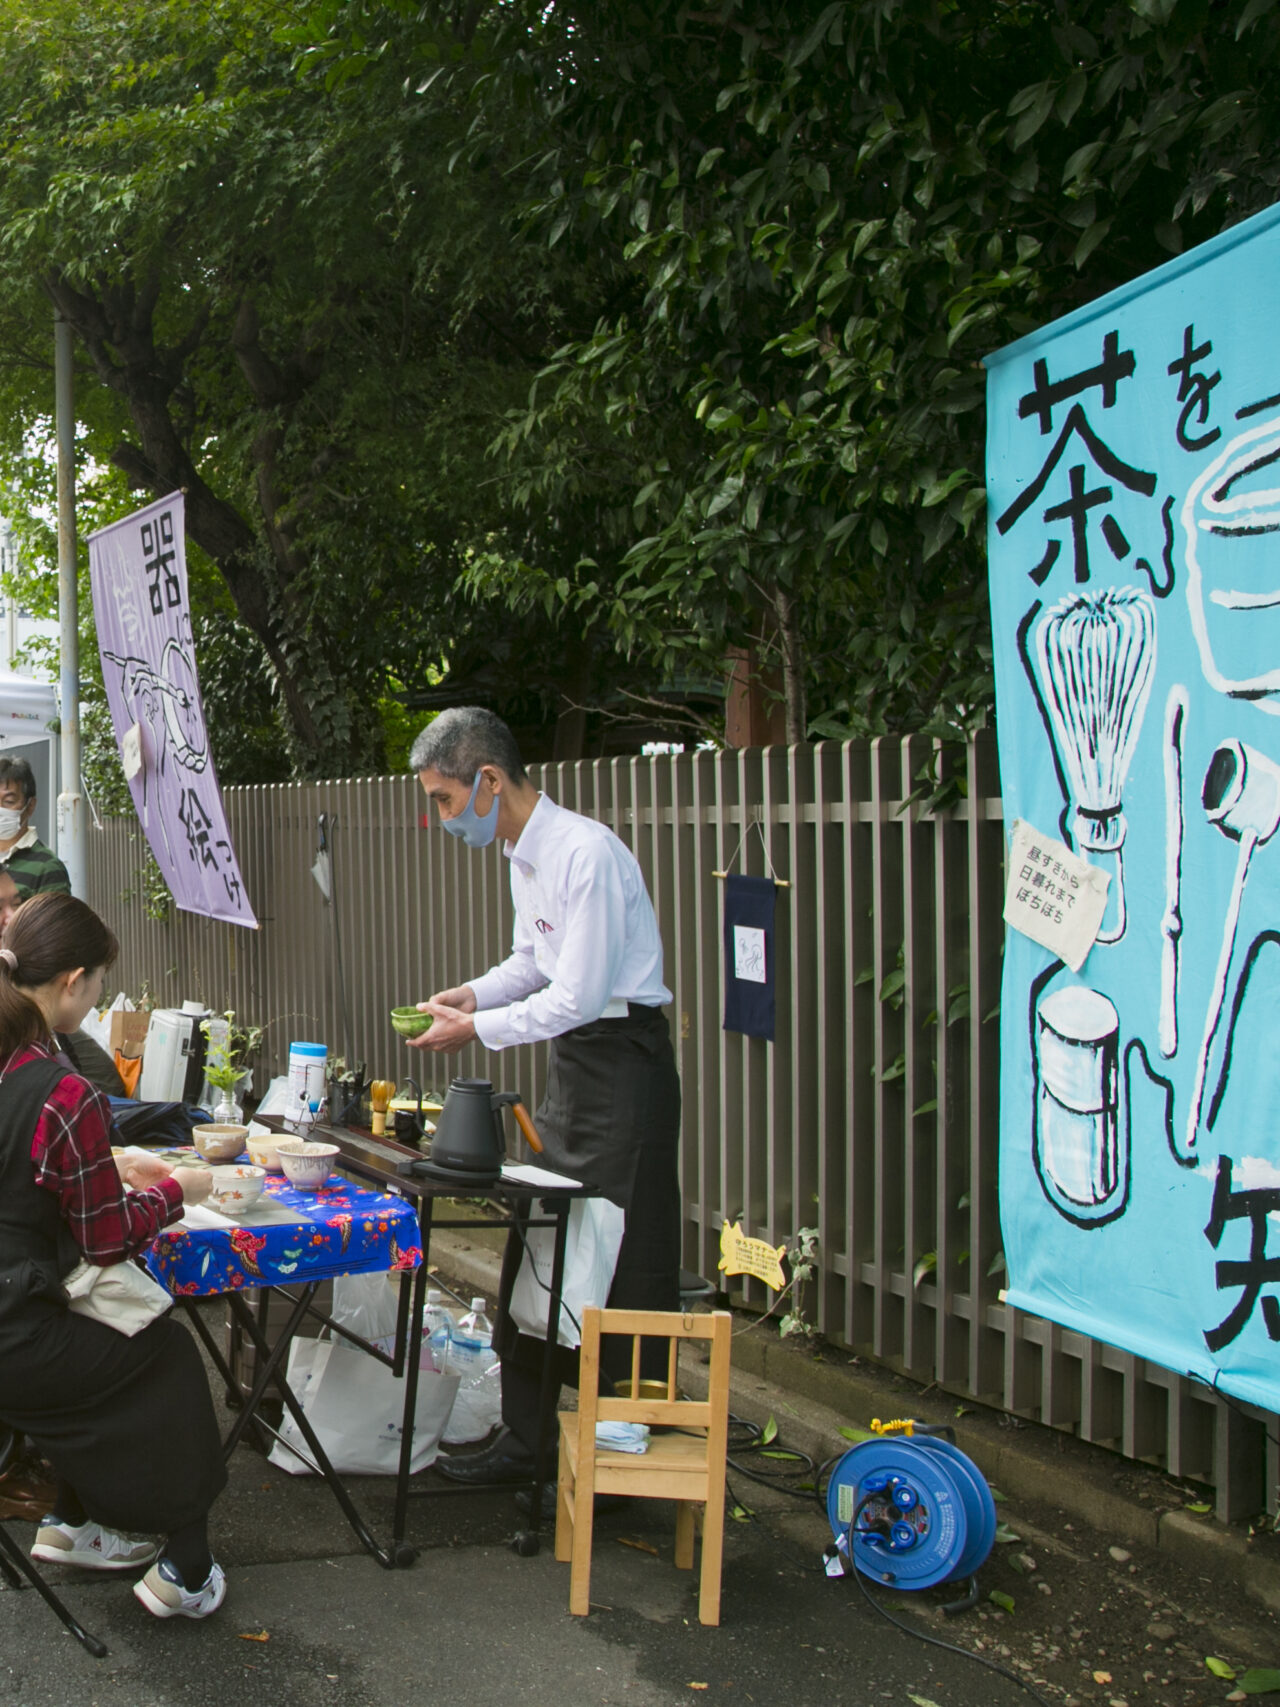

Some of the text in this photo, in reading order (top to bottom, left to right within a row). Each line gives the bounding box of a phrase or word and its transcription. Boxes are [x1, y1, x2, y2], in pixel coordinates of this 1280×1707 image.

[1019, 864, 1077, 909] 日暮れまで
[1026, 845, 1080, 889] 昼すぎから
